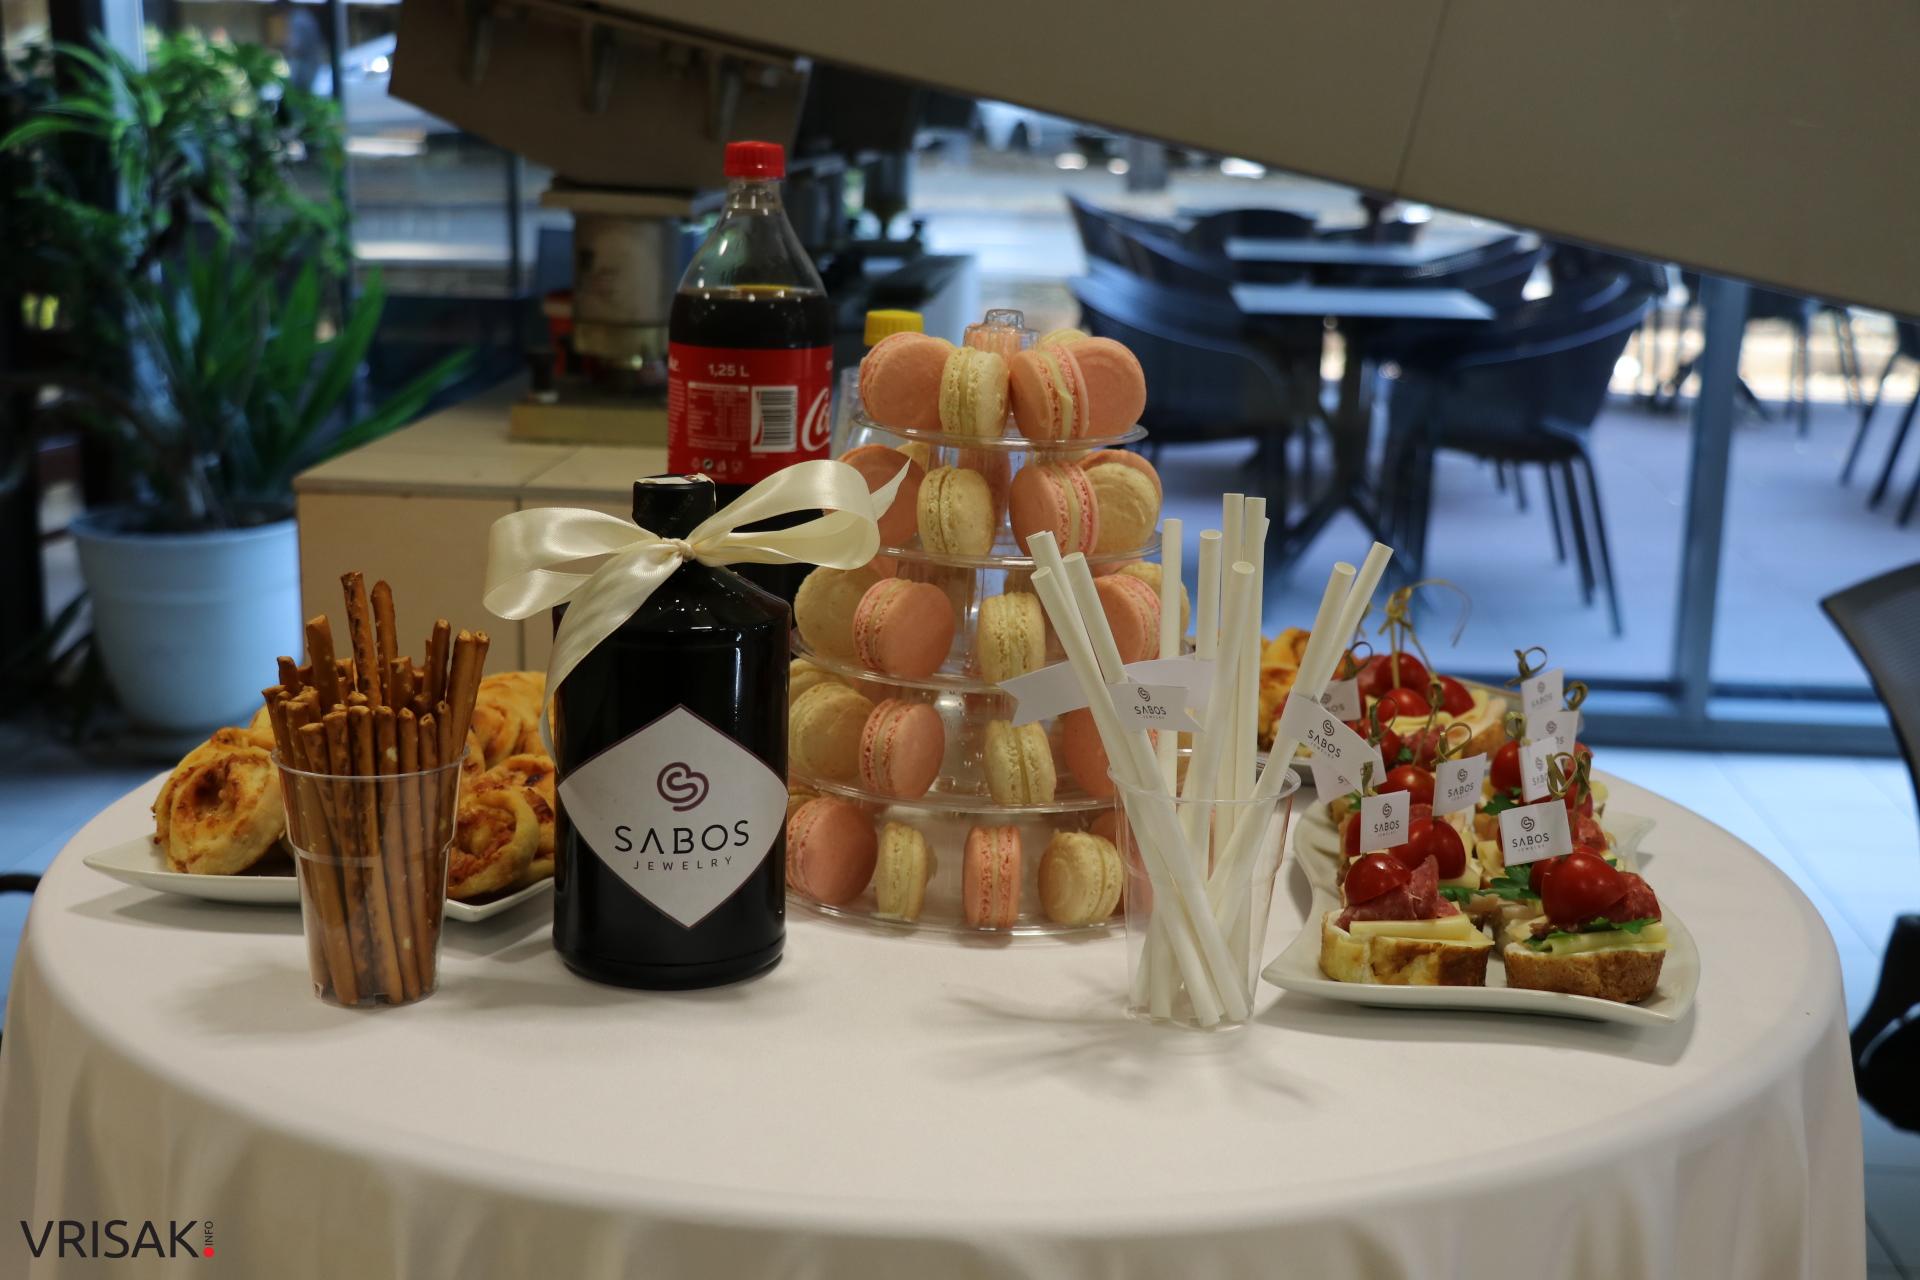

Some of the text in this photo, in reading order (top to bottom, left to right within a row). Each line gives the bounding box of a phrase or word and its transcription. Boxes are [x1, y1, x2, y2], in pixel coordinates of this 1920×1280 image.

[708, 363, 750, 378] 1,25 L
[1134, 705, 1167, 715] SABOS
[1307, 729, 1342, 758] SABOS
[1447, 782, 1474, 798] SABOS
[1373, 820, 1400, 833] SABOS
[613, 819, 750, 855] SABOS
[1511, 833, 1550, 848] SABOS
[633, 855, 732, 871] JEWELRY
